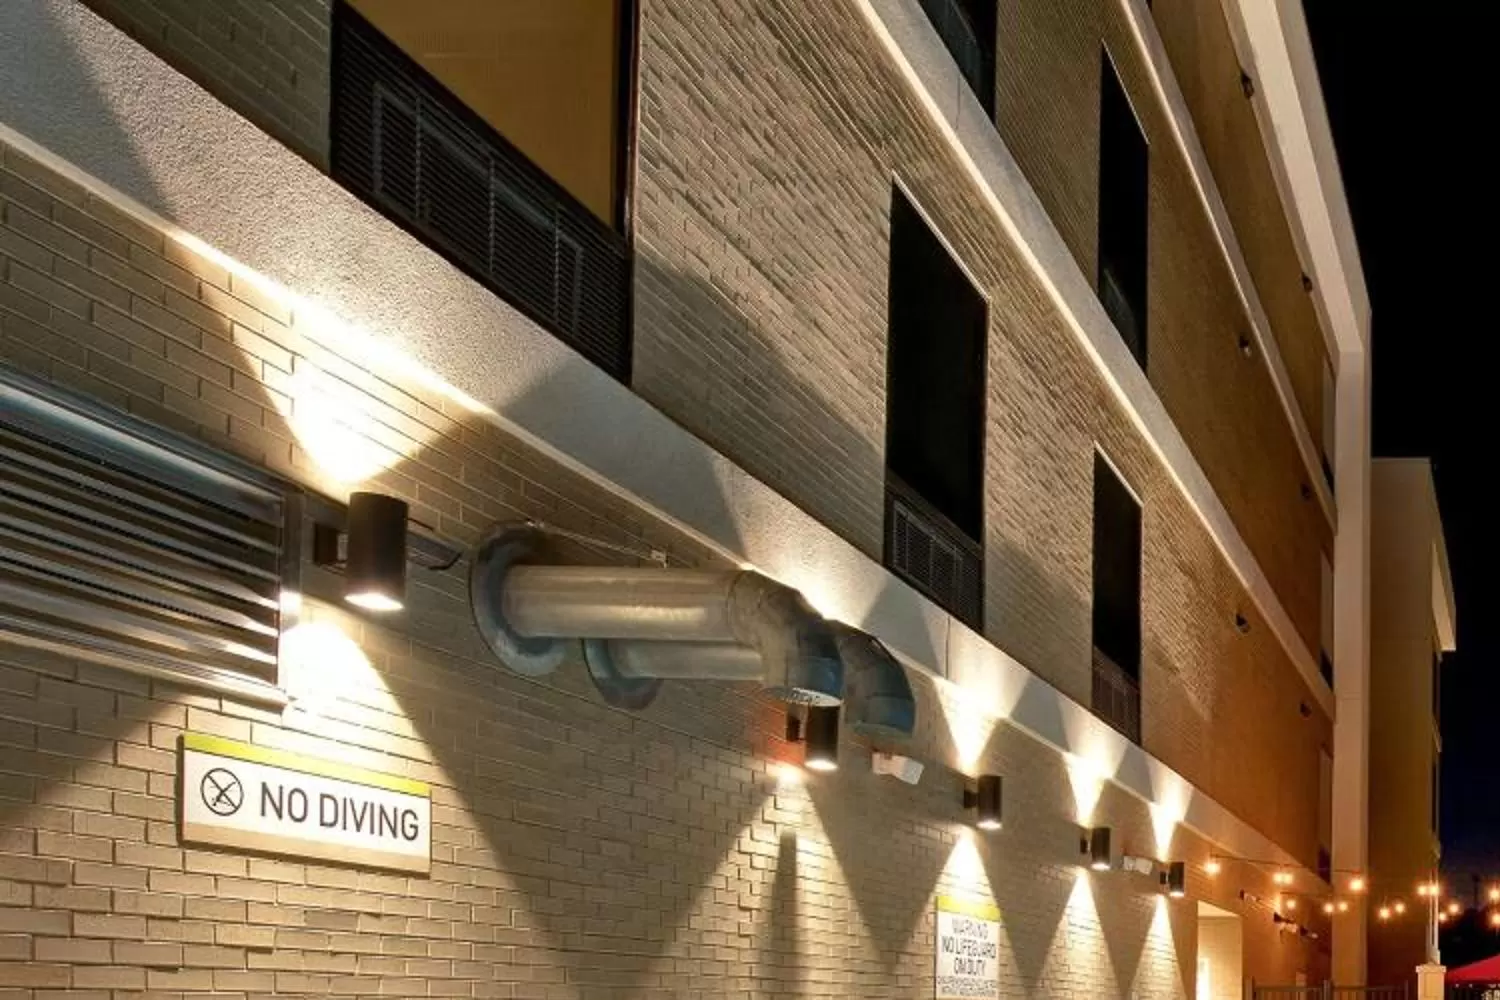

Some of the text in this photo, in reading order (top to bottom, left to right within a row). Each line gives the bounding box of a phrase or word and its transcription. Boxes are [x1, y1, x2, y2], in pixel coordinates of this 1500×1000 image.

[260, 782, 419, 841] NO DIVING
[941, 936, 954, 953] NO
